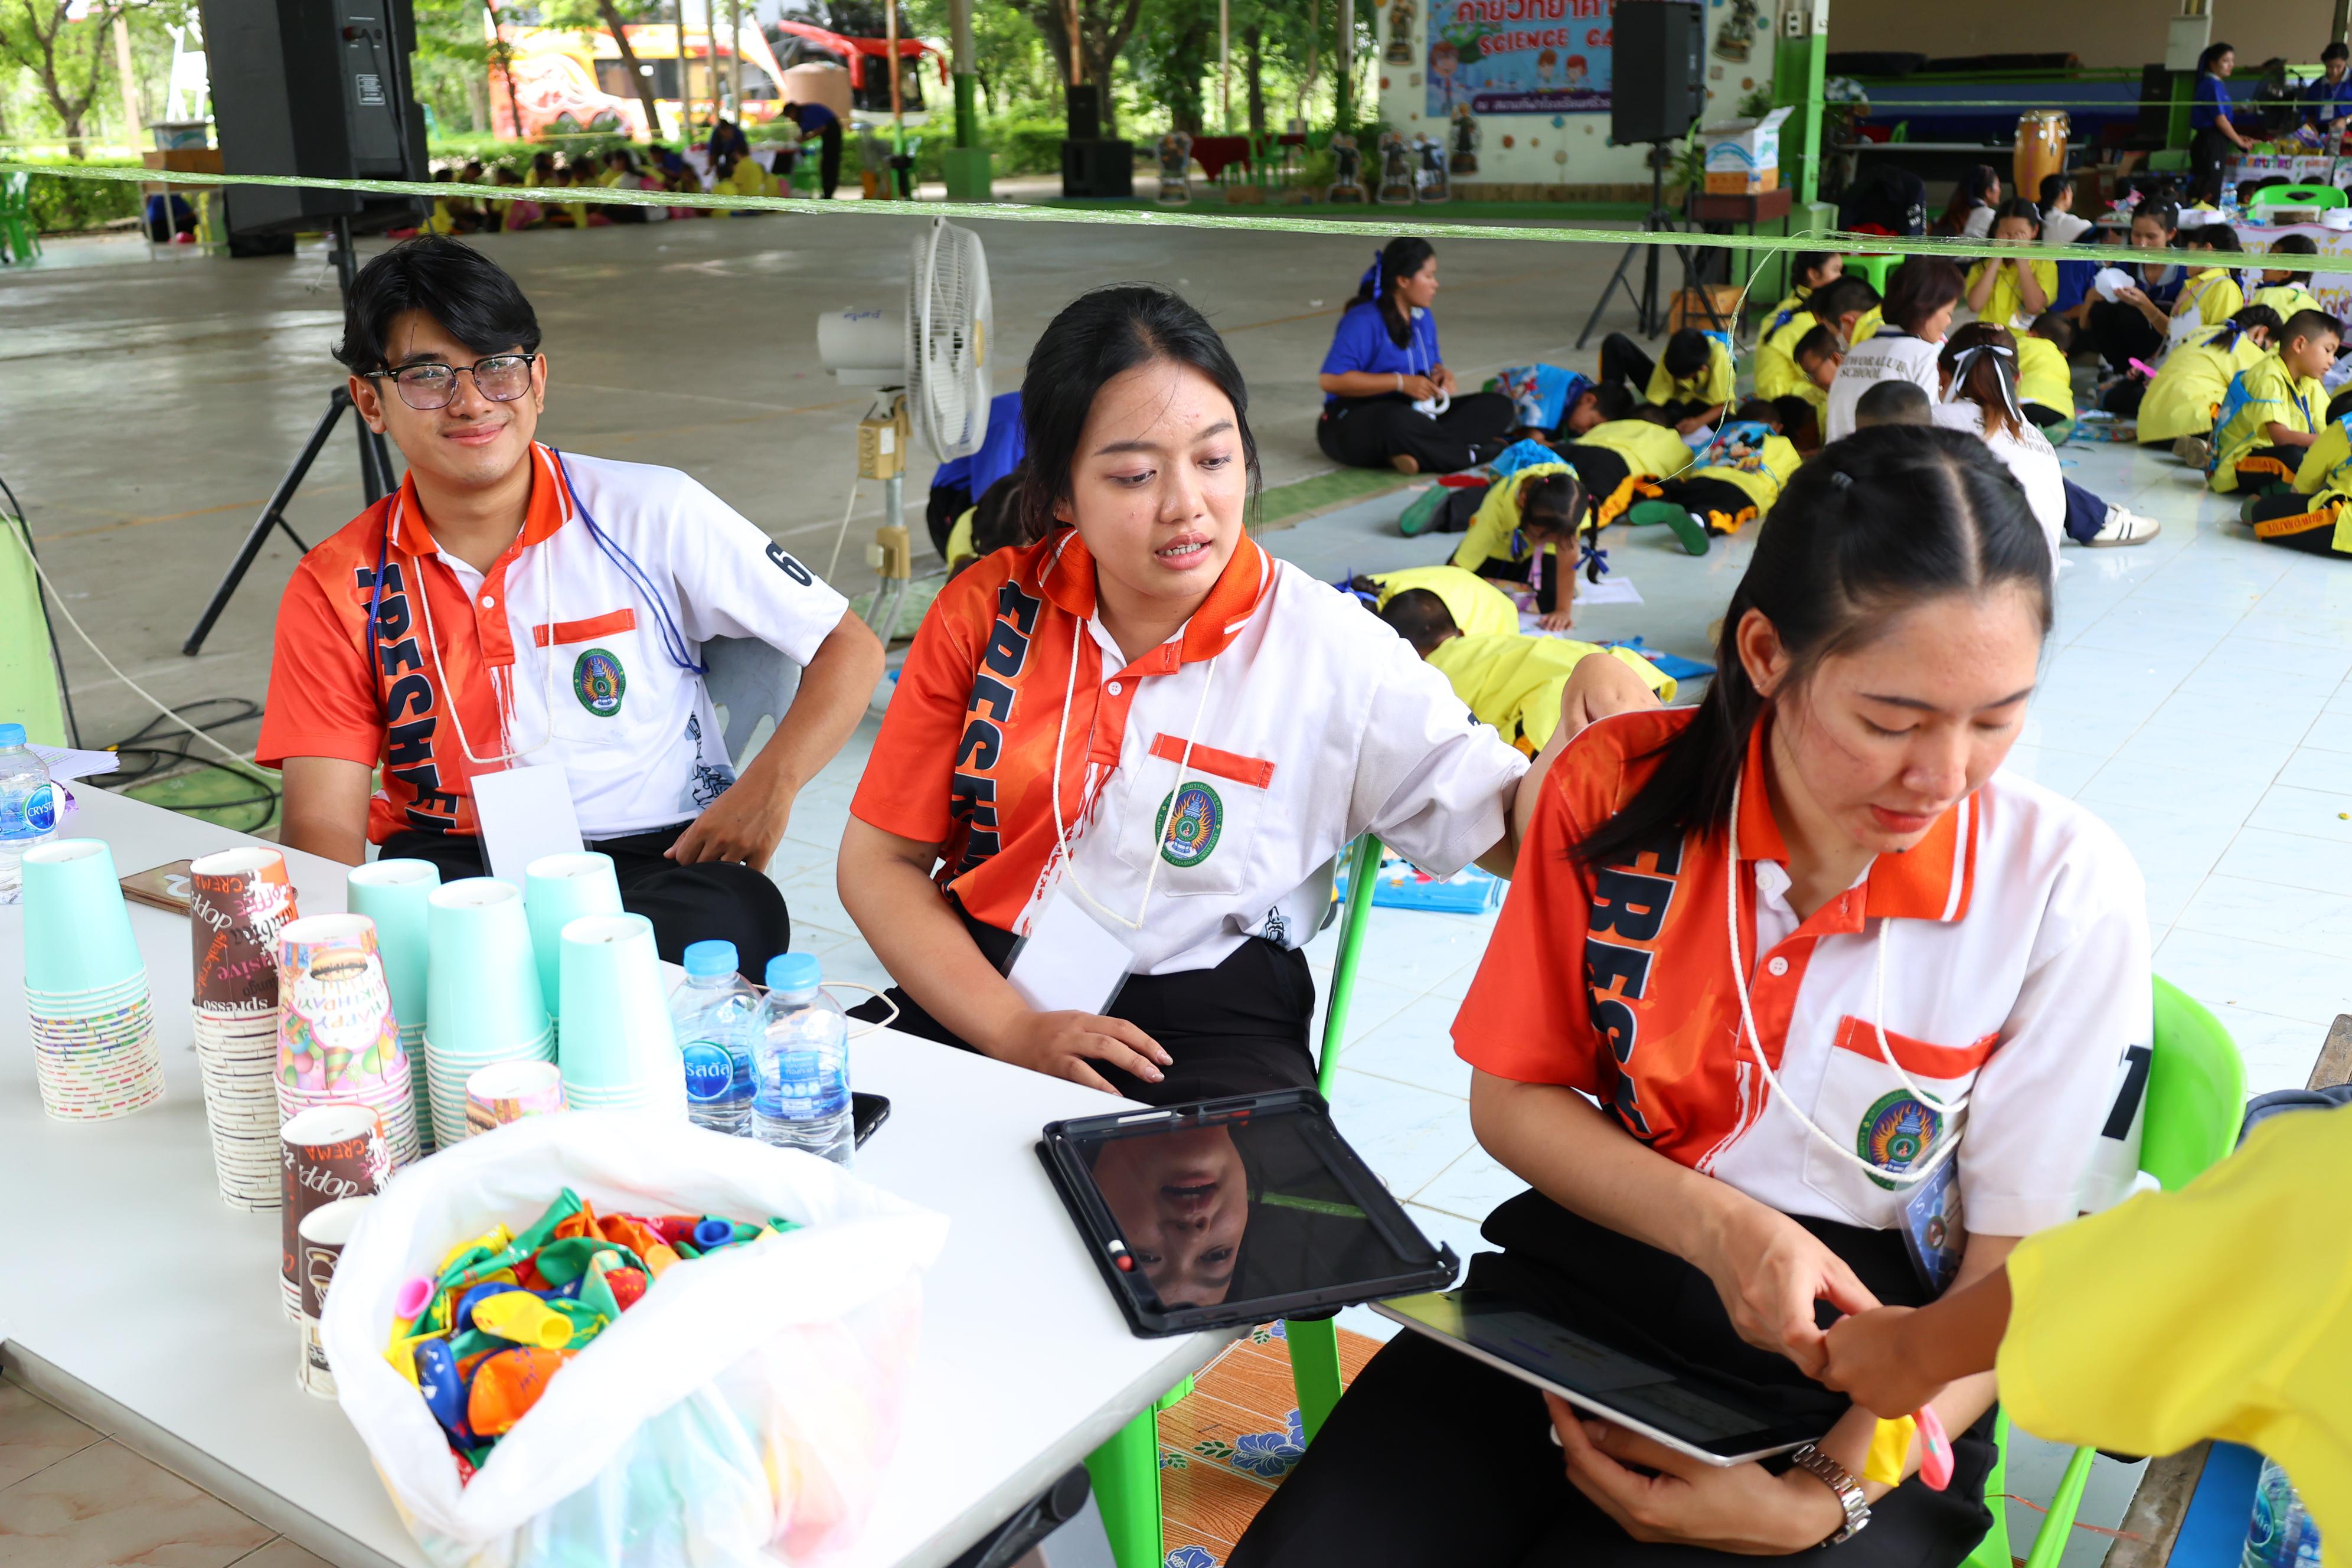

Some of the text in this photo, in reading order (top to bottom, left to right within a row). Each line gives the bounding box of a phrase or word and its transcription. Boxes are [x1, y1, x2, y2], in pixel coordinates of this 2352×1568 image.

[1478, 28, 1569, 55] SCIENCE
[766, 540, 815, 587] 6
[1199, 833, 1219, 861] UNIVERSITY
[315, 1001, 382, 1030] HAPPY
[2101, 1044, 2154, 1141] 1
[303, 1139, 366, 1162] CREMA
